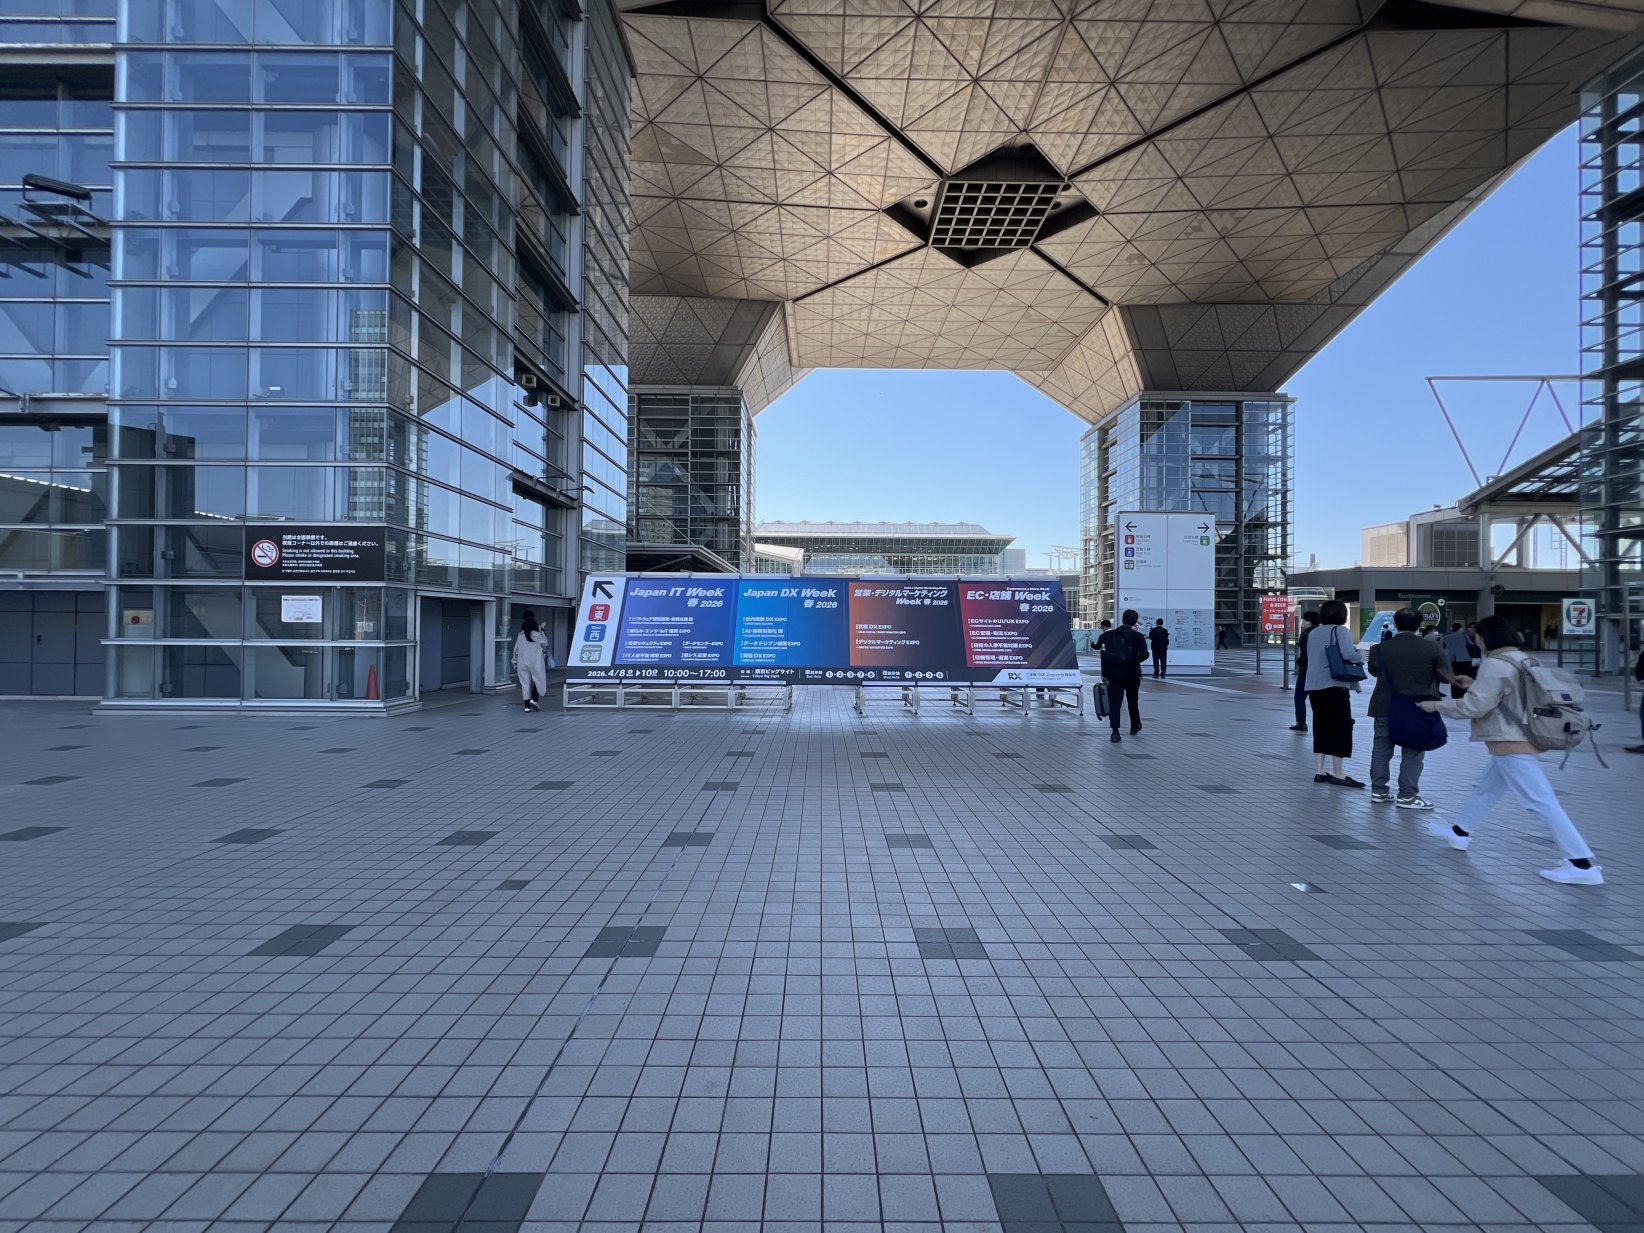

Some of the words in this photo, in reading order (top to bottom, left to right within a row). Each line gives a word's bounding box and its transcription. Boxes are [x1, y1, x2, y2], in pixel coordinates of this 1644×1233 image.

[630, 588, 667, 597] Japan
[669, 588, 685, 596] IT
[686, 588, 725, 596] Week
[744, 589, 778, 598] Japan
[780, 589, 799, 597] DX
[801, 589, 837, 597] Week
[854, 589, 948, 598] 営業・デジタルマーケティング
[966, 590, 1012, 600] EC・店舗
[1014, 591, 1051, 600] Week
[687, 598, 699, 607] 春
[804, 599, 814, 608] 春
[1019, 603, 1029, 612] 春
[594, 610, 604, 620] 東
[590, 631, 600, 640] 西
[582, 651, 600, 660] 会議
